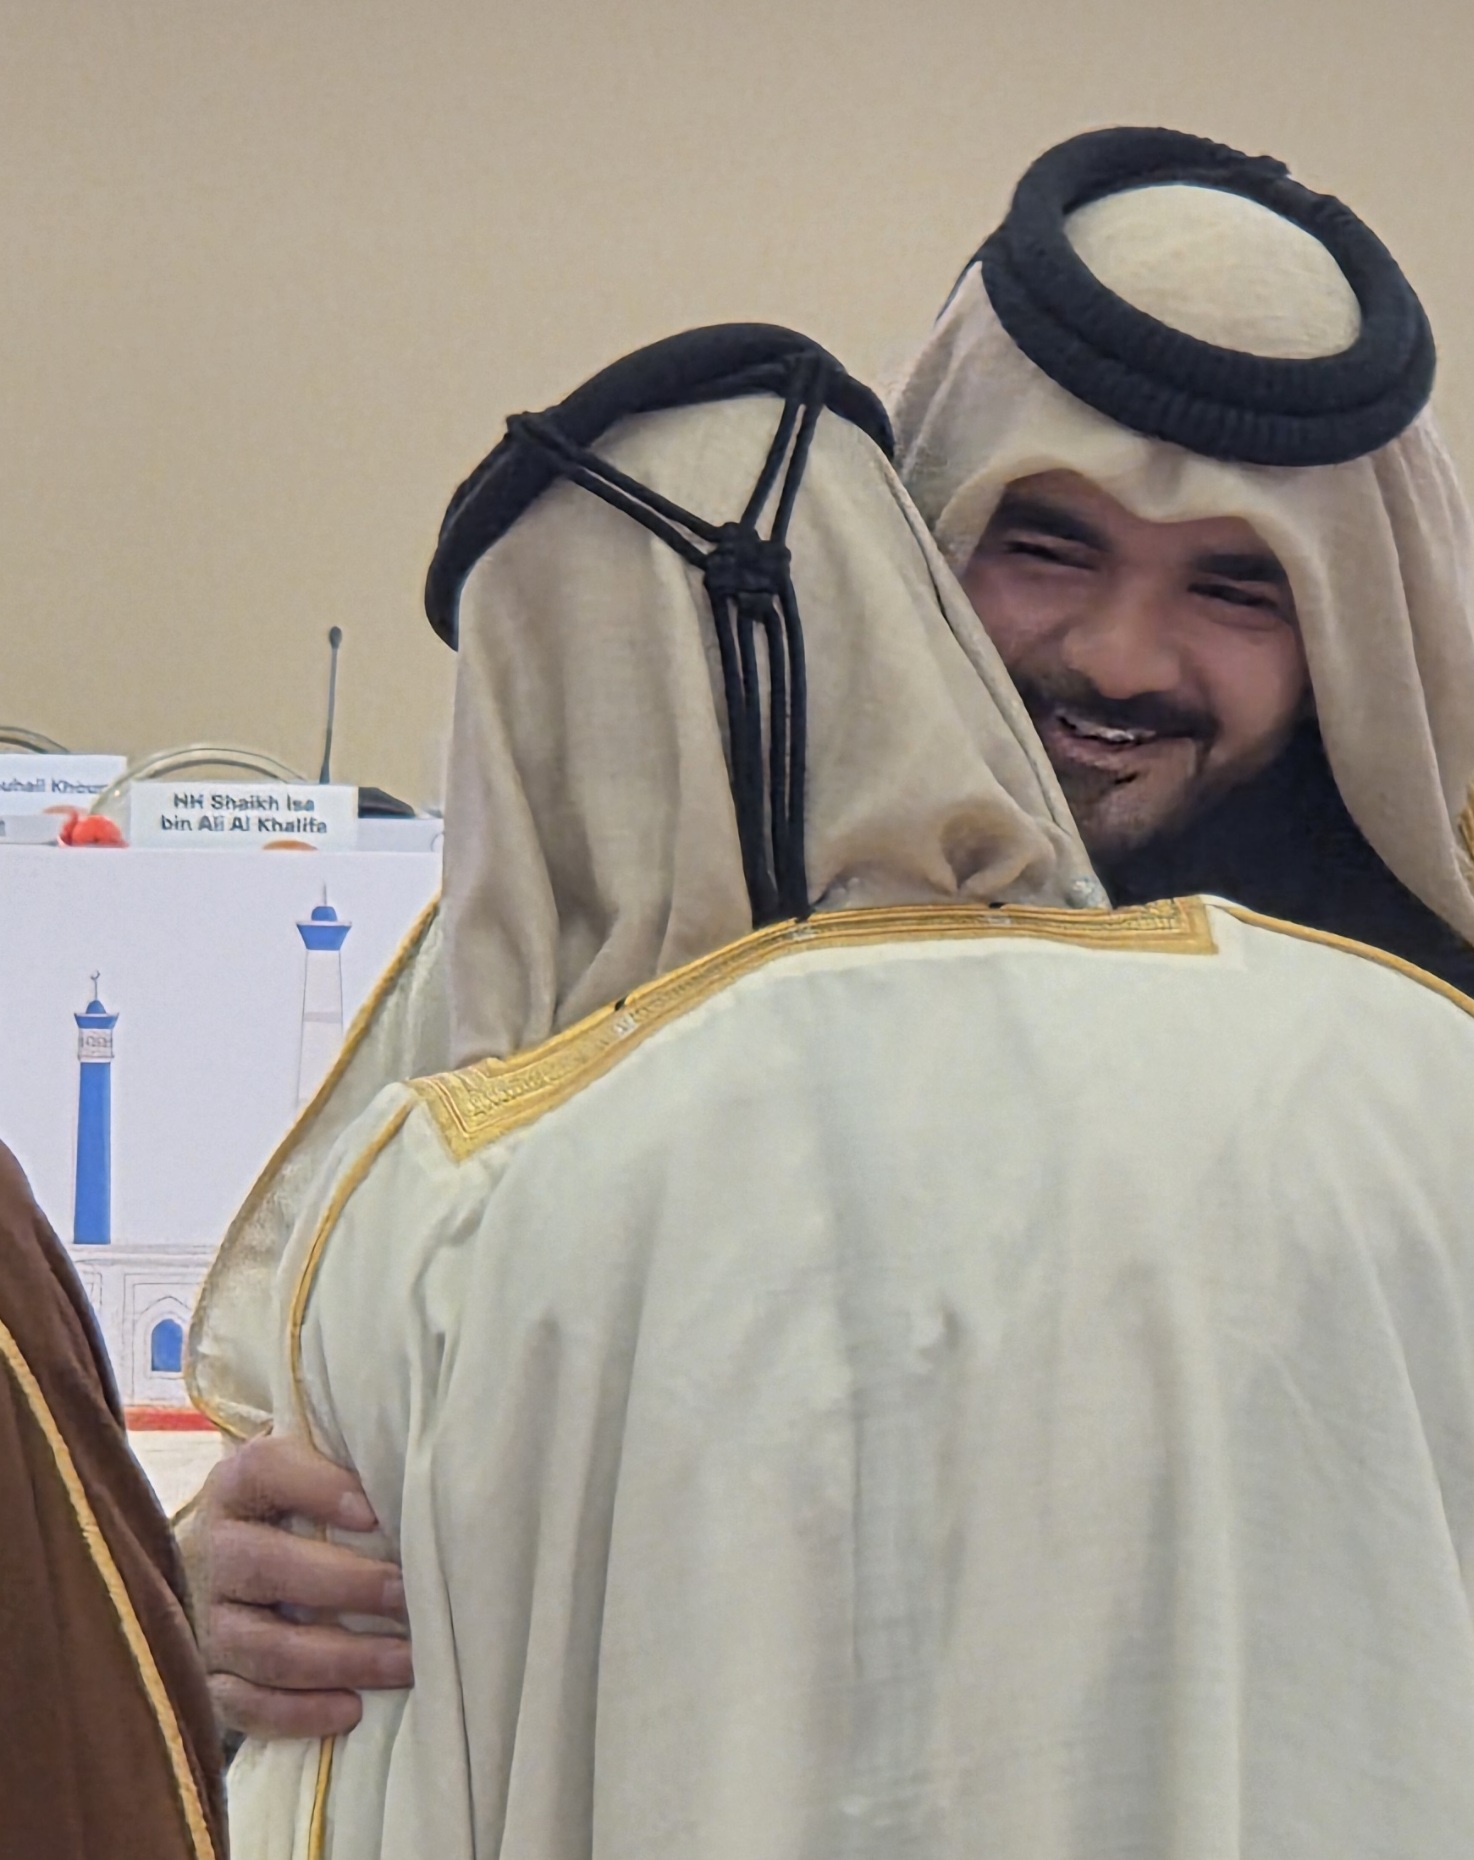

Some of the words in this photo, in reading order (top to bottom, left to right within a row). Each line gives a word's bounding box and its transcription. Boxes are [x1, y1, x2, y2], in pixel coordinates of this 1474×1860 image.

[174, 793, 204, 809] HH
[211, 794, 279, 811] Shaikh
[287, 794, 315, 811] Isa
[161, 815, 192, 831] bin
[199, 816, 225, 832] Ali
[230, 816, 250, 832] Al
[258, 817, 327, 833] Khalifa
